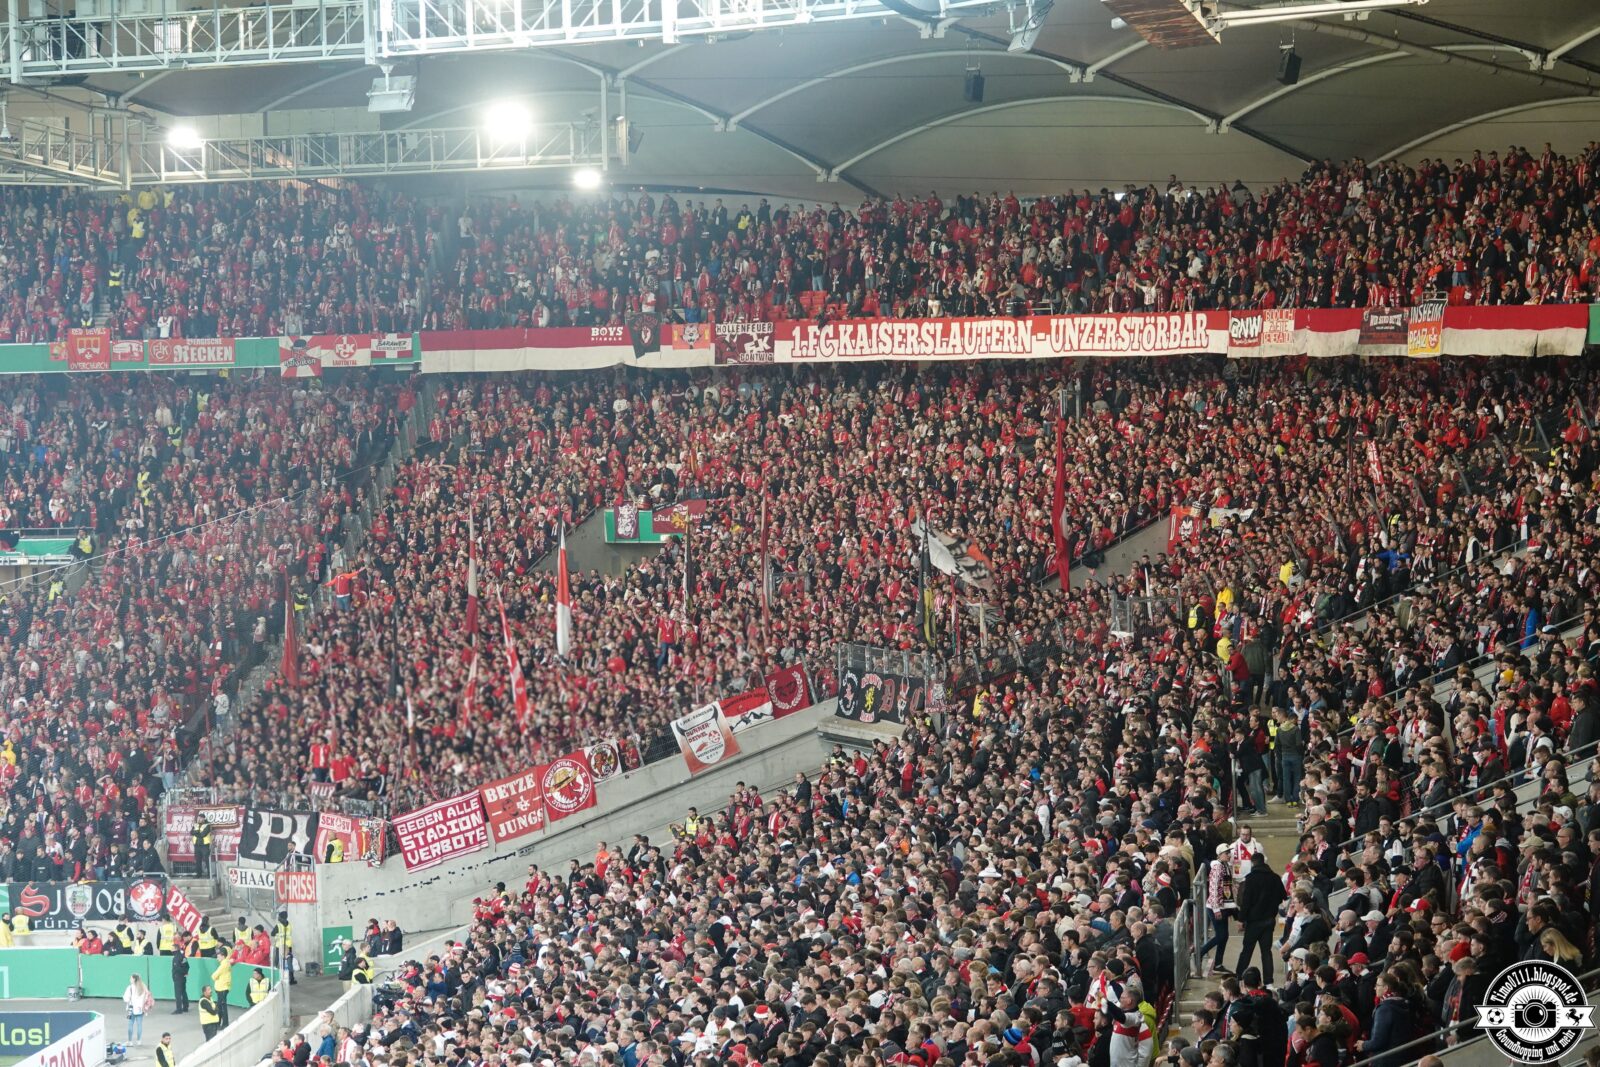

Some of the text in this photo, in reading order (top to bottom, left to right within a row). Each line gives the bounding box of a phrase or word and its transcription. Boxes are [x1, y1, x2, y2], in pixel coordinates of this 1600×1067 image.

[1410, 303, 1443, 324] INSHEIM
[591, 327, 623, 336] BOYS
[838, 319, 1032, 356] KAISERSLAUTERN
[1050, 313, 1208, 353] UNZERSTÖRBAR
[173, 345, 232, 362] RECKEN
[484, 773, 536, 803] BETZE
[397, 798, 479, 836] GEGEN ALLE
[400, 811, 483, 850] STADION
[498, 808, 544, 838] JUNGS
[407, 827, 487, 865] VERBOTE
[239, 870, 274, 887] HAAG
[277, 873, 316, 900] CHRISSI
[1, 1022, 50, 1045] los!
